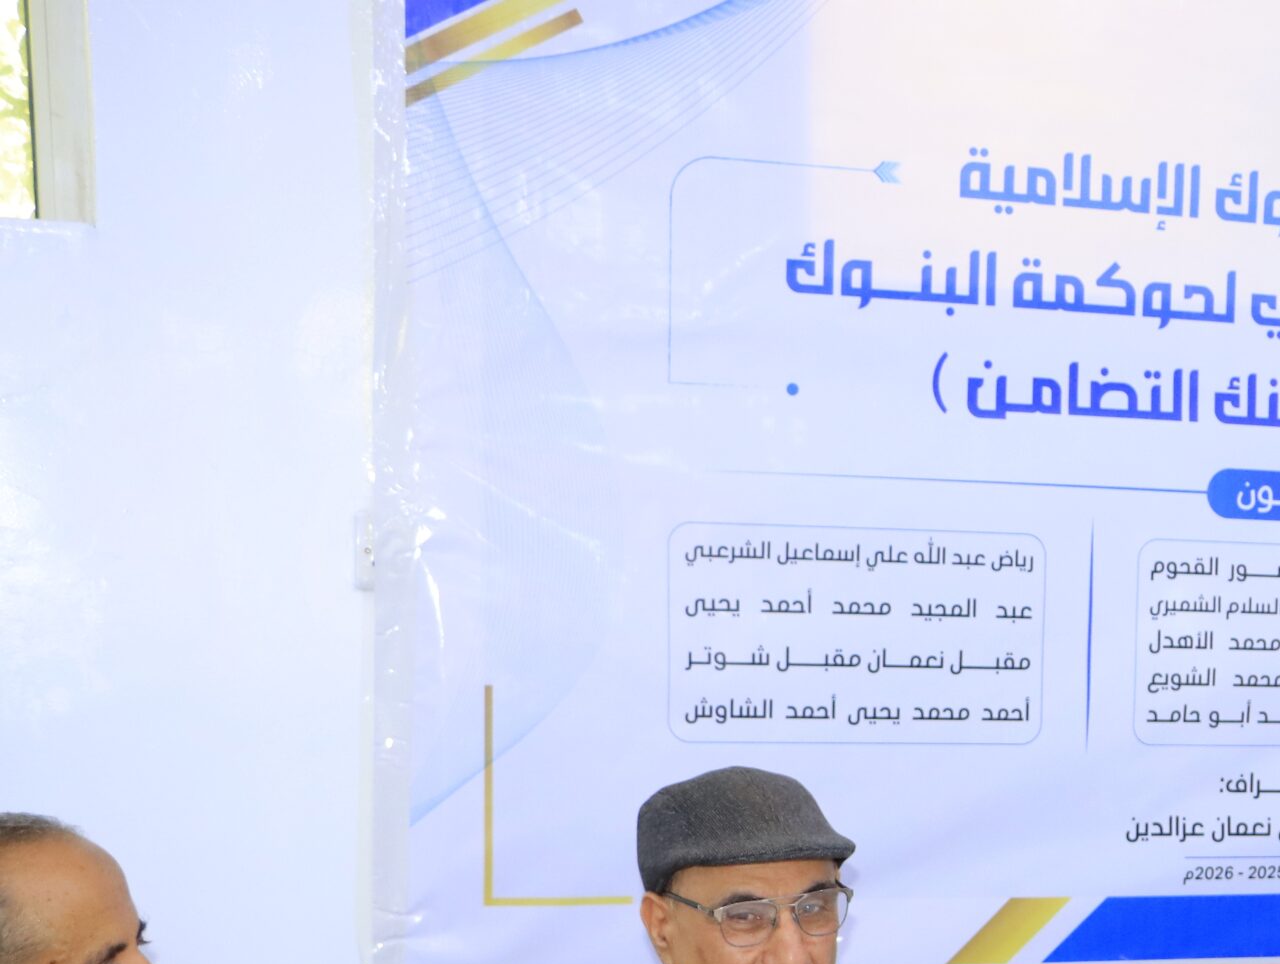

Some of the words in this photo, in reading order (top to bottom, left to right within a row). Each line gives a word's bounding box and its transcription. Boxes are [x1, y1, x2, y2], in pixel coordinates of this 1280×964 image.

[959, 146, 1201, 231] الإسلامية
[786, 238, 998, 317] البنوك
[1012, 257, 1236, 329] لحوكمة
[966, 359, 1199, 423] التضامن
[685, 539, 771, 567] الشرعبي
[777, 541, 860, 568] إسماعيل
[866, 546, 908, 572] علي
[914, 537, 946, 565] الله
[951, 552, 986, 570] عبد
[991, 550, 1034, 573] رياض
[1150, 556, 1219, 581] القحوم
[685, 597, 740, 617] يحيى
[760, 587, 813, 614] أحمد
[832, 600, 892, 616] محمد
[911, 598, 977, 622] المجيد
[996, 603, 1033, 623] عبد
[1149, 594, 1221, 621] الشميري
[1149, 629, 1213, 654] الأهدل
[1228, 637, 1280, 651] محمد
[685, 644, 770, 671] شوتر
[776, 646, 861, 672] مقبل
[868, 648, 944, 673] نعمان
[950, 649, 1031, 675] مقبل
[1147, 666, 1216, 693] الشويع
[685, 697, 773, 724] الشاوش
[785, 694, 837, 720] أحمد
[848, 705, 901, 725] يحيى
[912, 705, 970, 721] محمد
[981, 696, 1030, 722] أحمد
[1146, 704, 1201, 723] حامد
[1208, 700, 1251, 728] أبو
[1126, 815, 1205, 843] عزالدين
[1212, 815, 1272, 843] نعمان
